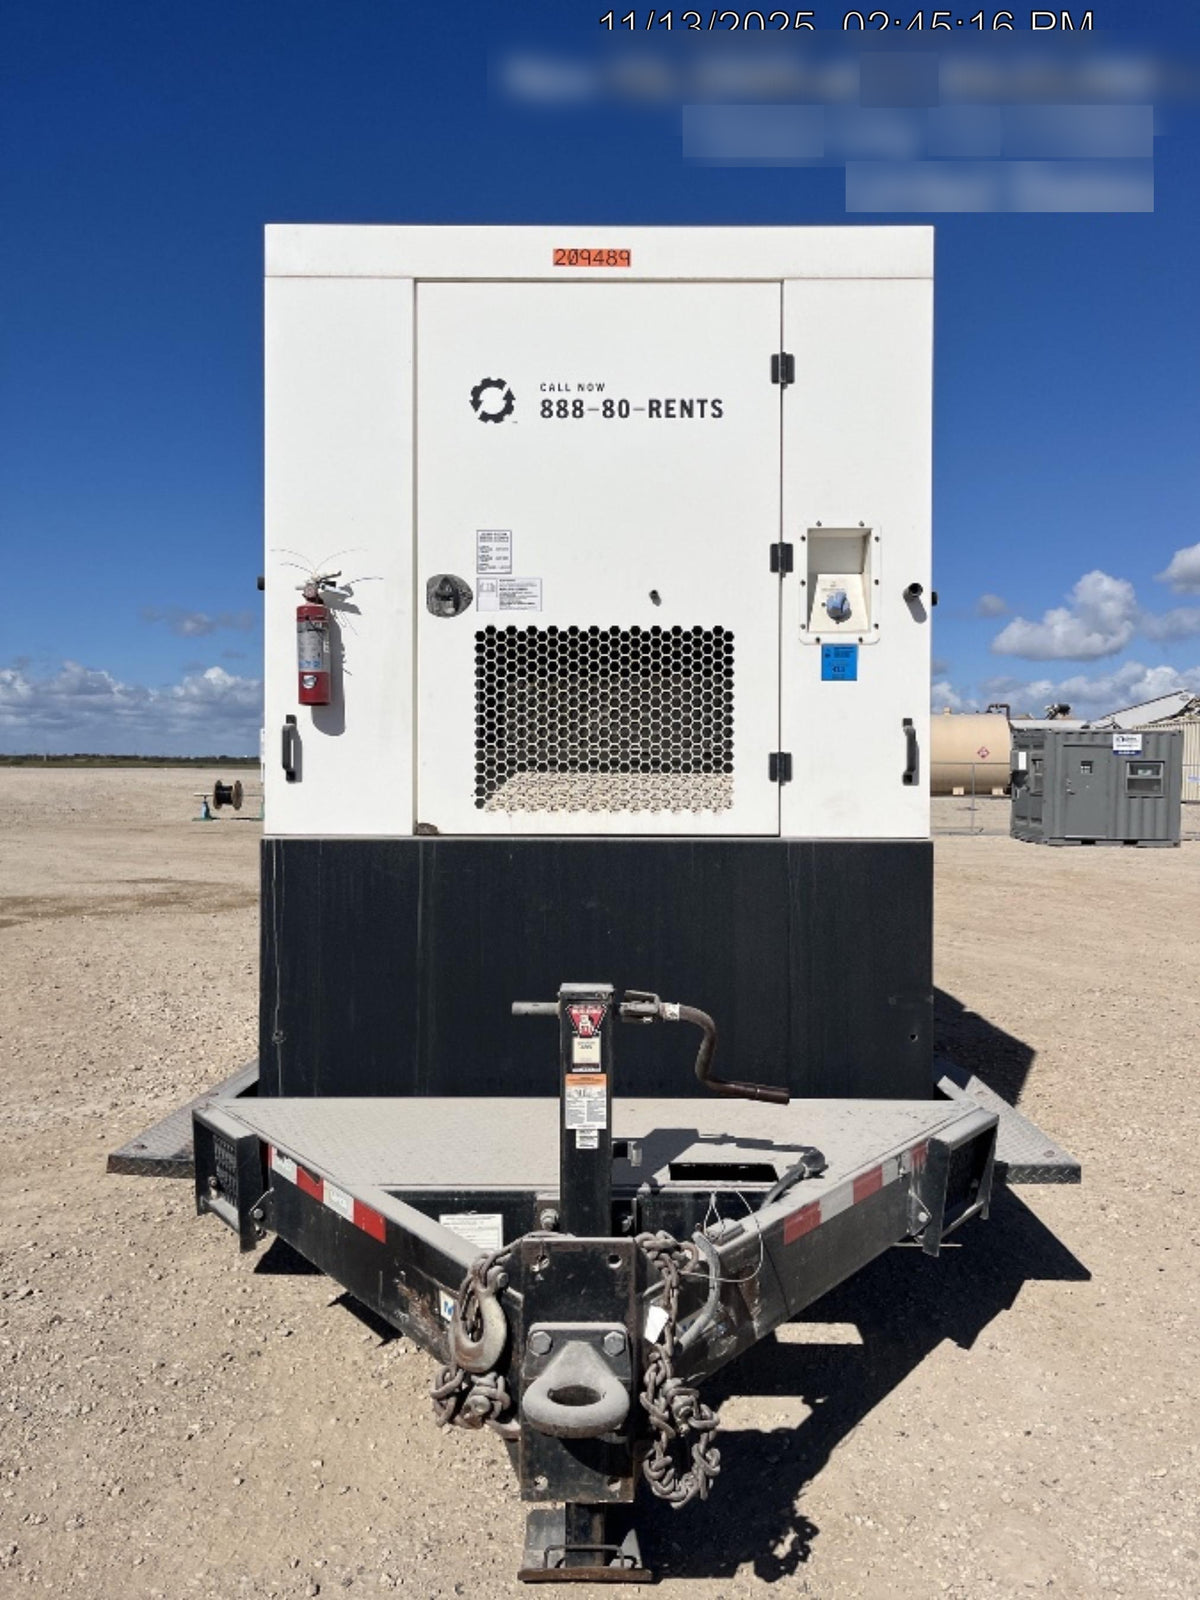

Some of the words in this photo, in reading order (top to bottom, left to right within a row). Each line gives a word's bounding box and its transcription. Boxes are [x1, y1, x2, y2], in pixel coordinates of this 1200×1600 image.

[553, 249, 631, 266] 209489
[540, 382, 571, 392] CALL
[577, 382, 605, 392] NOW
[540, 398, 724, 419] 888-80-RENTS
